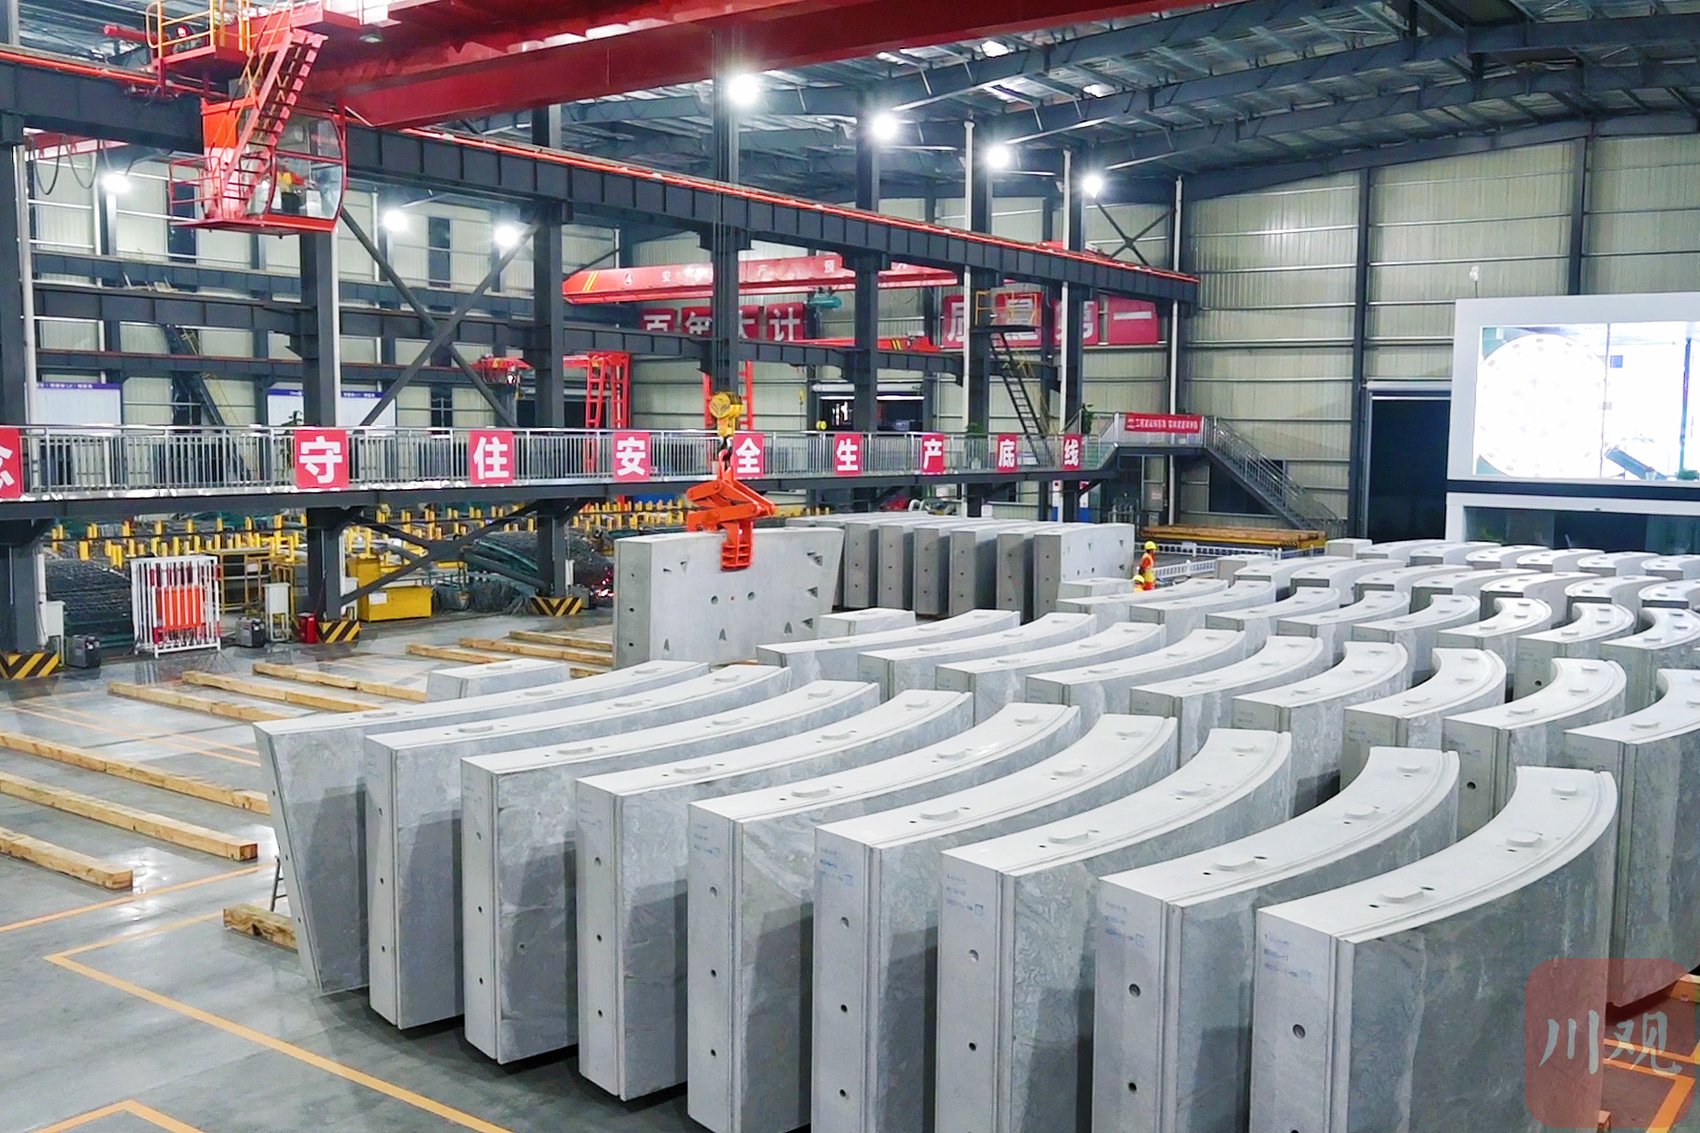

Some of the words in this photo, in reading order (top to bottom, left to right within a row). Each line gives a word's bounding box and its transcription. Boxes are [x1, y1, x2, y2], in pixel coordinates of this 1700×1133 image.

[299, 434, 1080, 484] 守住安全生产底线
